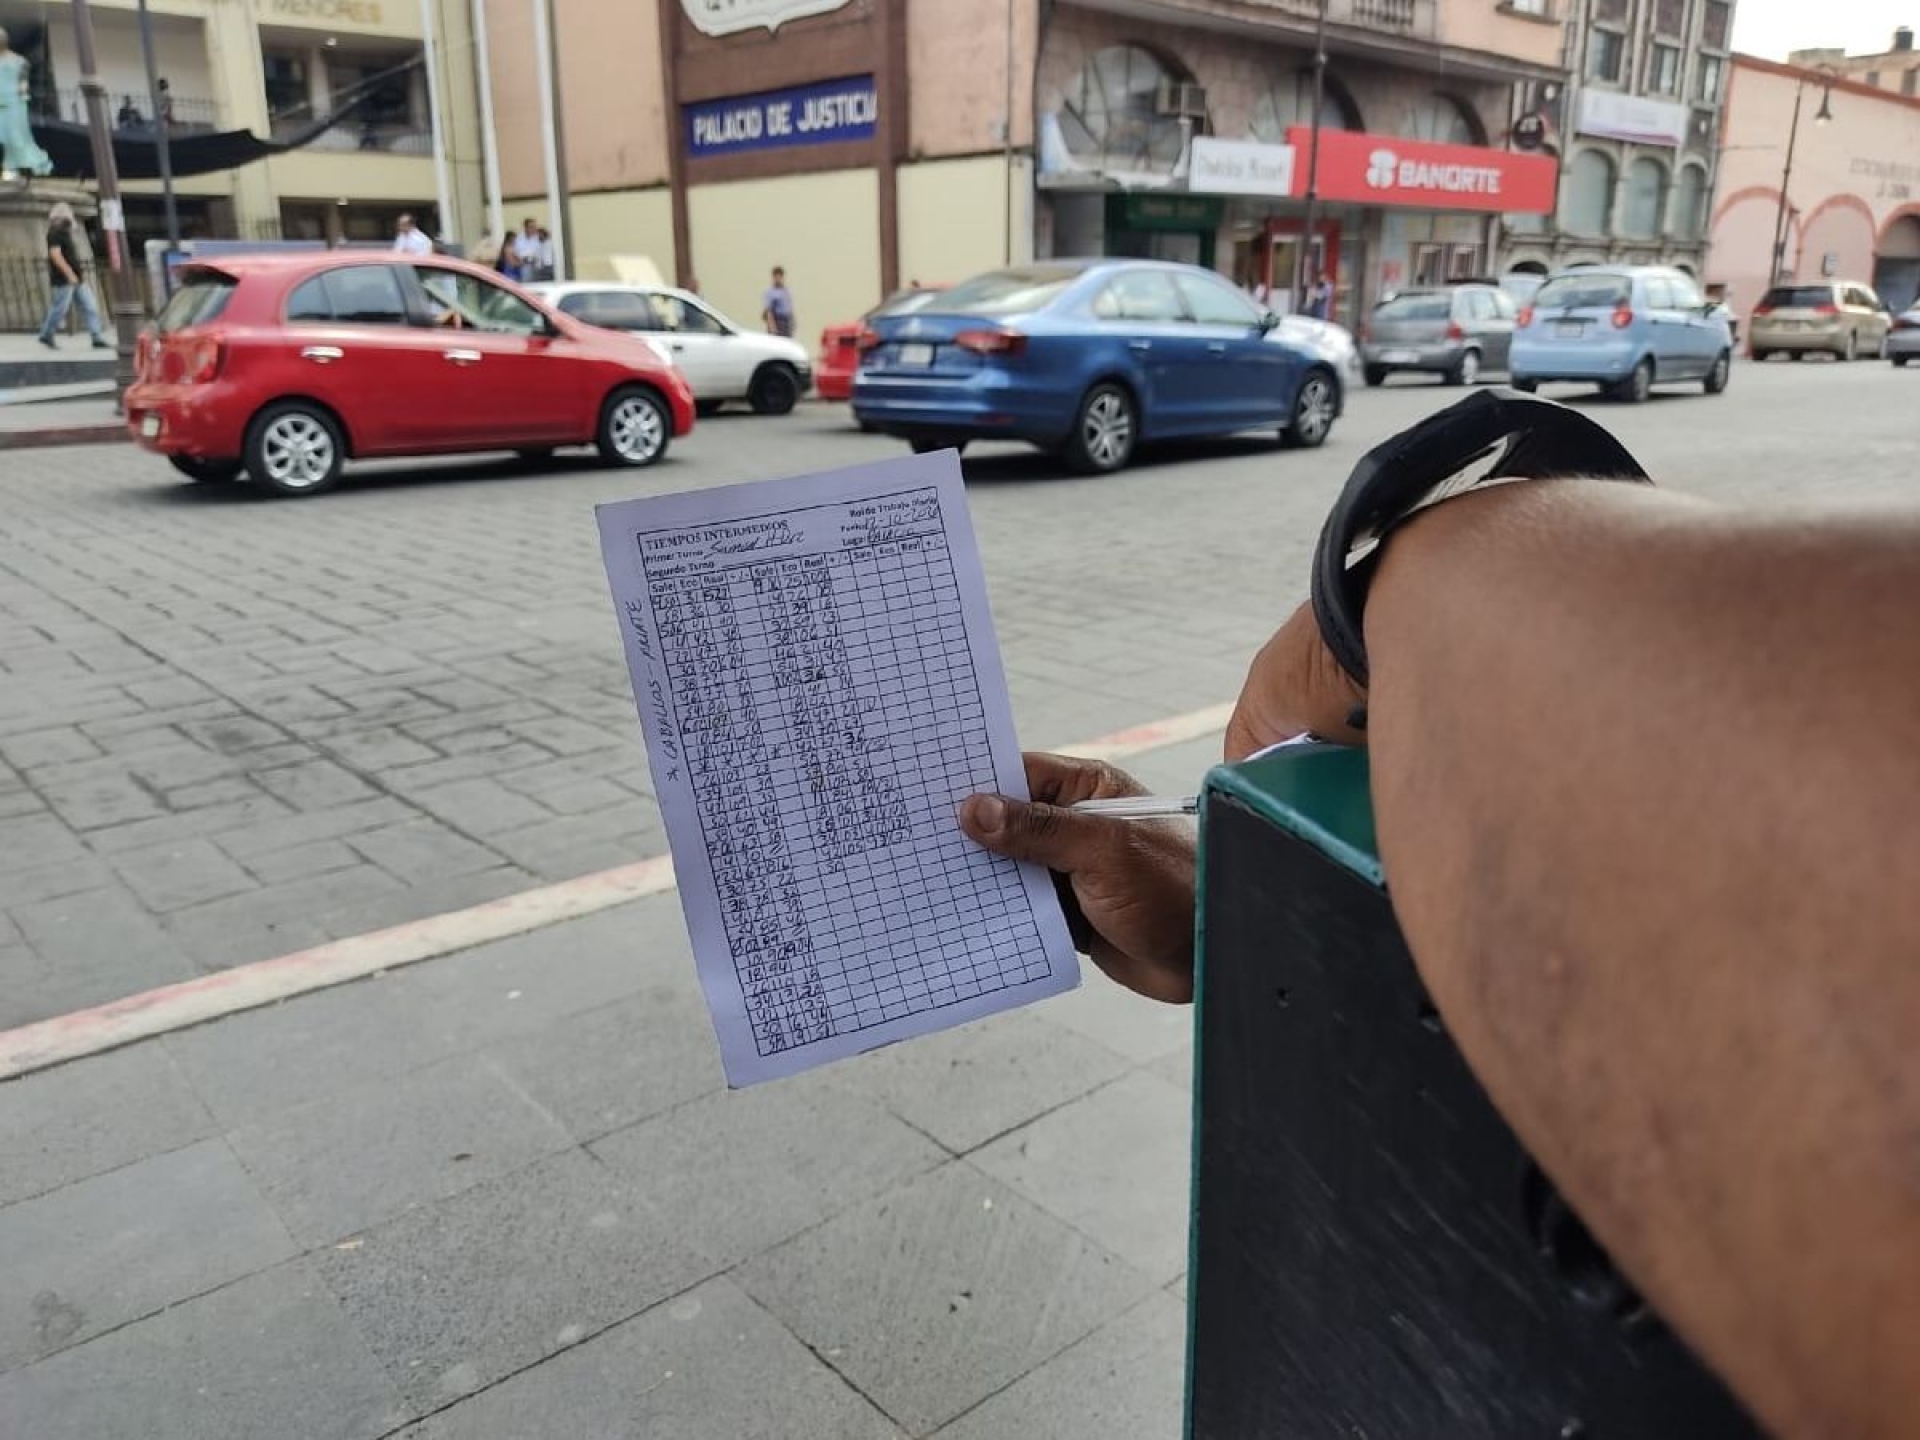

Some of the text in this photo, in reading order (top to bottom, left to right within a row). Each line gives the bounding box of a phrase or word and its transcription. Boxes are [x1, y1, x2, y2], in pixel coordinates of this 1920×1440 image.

[693, 106, 763, 145] PALACIO
[767, 102, 793, 136] DE
[1399, 159, 1502, 194] BANORTE
[650, 581, 673, 593] Sale
